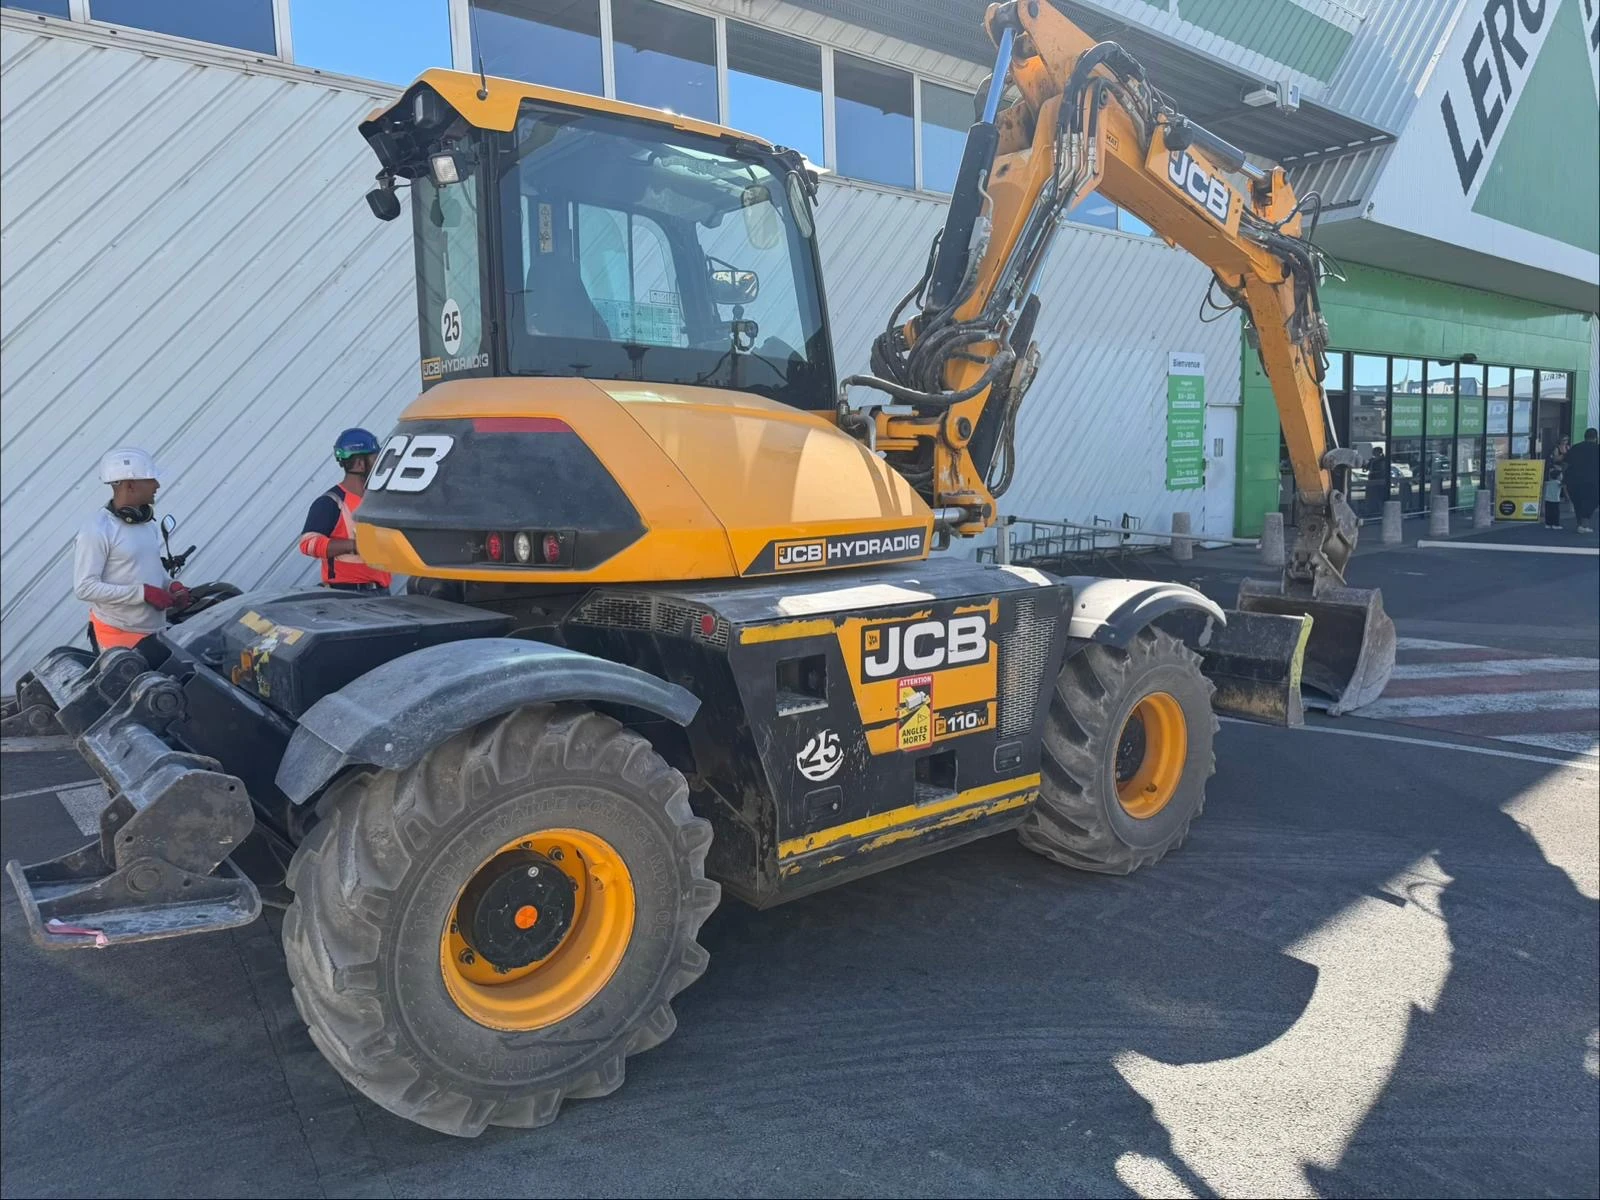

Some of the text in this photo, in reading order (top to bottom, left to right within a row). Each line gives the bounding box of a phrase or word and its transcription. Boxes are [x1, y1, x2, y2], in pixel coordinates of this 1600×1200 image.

[1169, 152, 1229, 220] JCB
[443, 310, 460, 342] 25
[423, 353, 489, 376] JCB HYDRADIG
[364, 435, 454, 492] CB
[779, 534, 921, 564] JCB HYDRADIG
[865, 615, 987, 677] JCB
[900, 675, 932, 687] ATTENTION
[902, 725, 928, 738] ANGLES
[903, 734, 927, 745] MORTS
